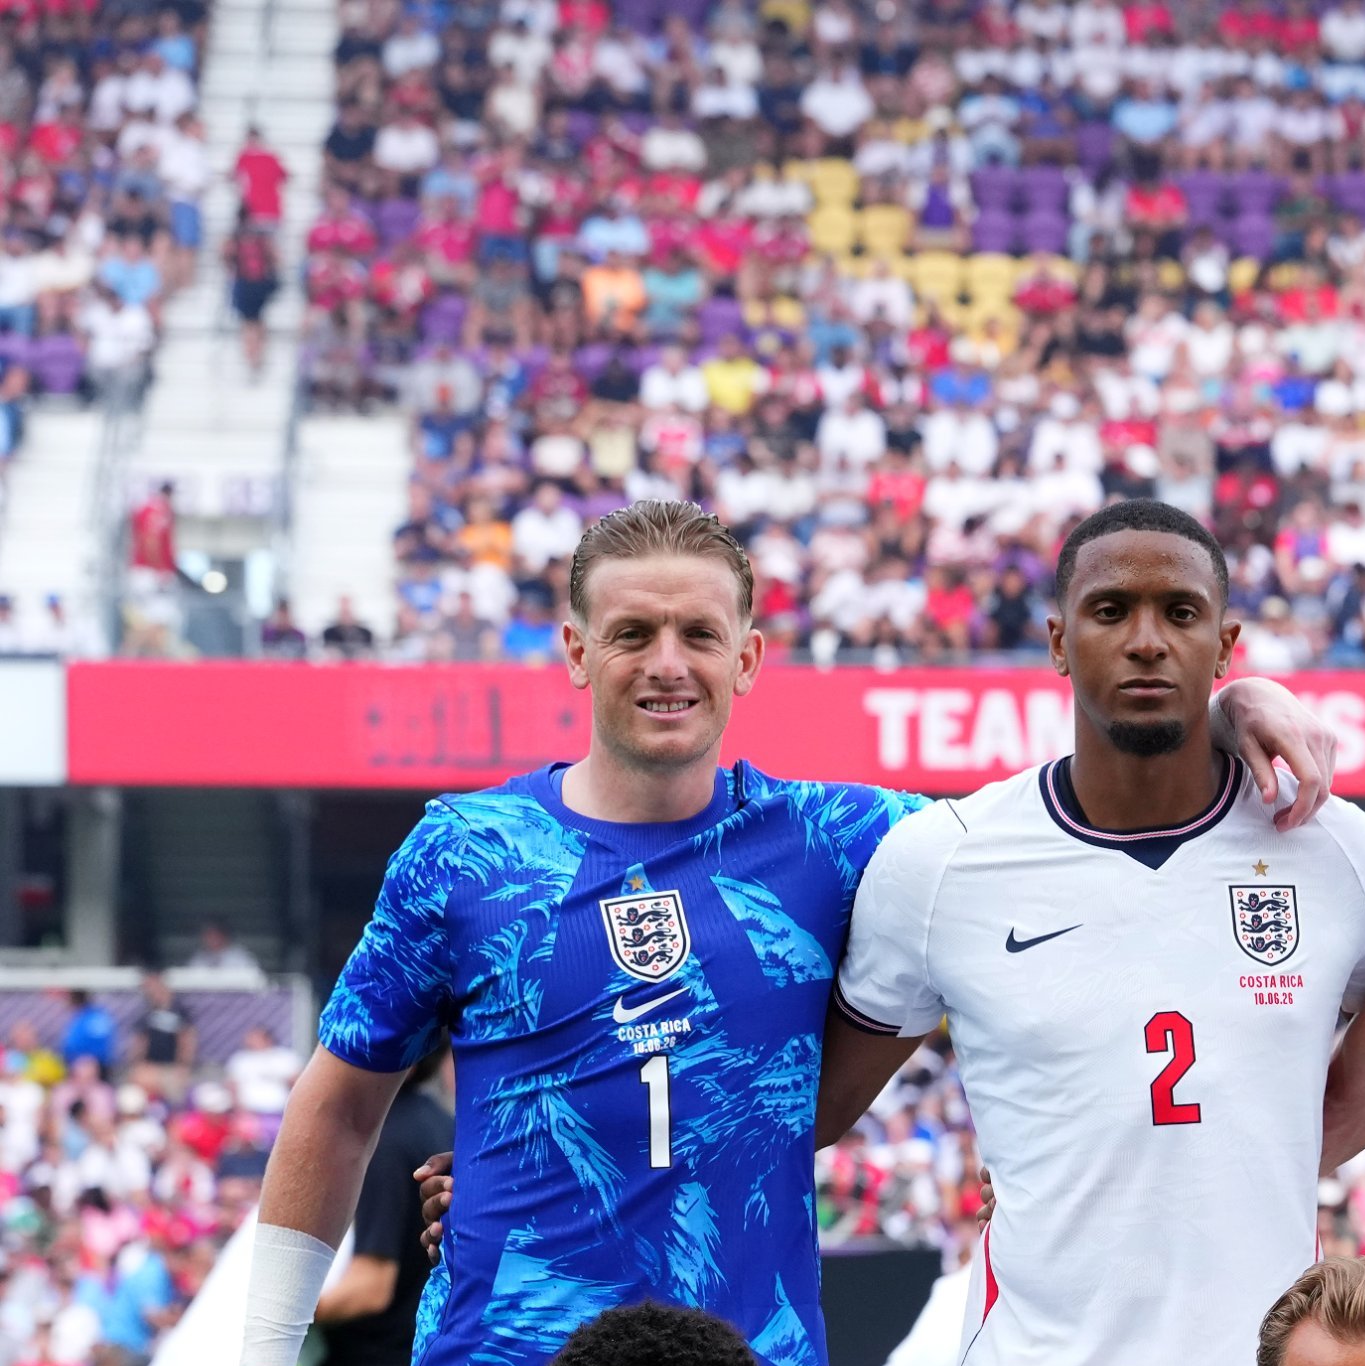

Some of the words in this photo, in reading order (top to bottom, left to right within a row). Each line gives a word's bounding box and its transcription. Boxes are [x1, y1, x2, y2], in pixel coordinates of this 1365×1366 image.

[1239, 974, 1277, 988] COSTA
[1279, 974, 1304, 988] RICA
[1254, 992, 1294, 1006] 10.06.26
[618, 1024, 659, 1042] COSTA
[661, 1017, 692, 1035] RICA
[1143, 1010, 1202, 1126] 2
[638, 1053, 673, 1169] 1
